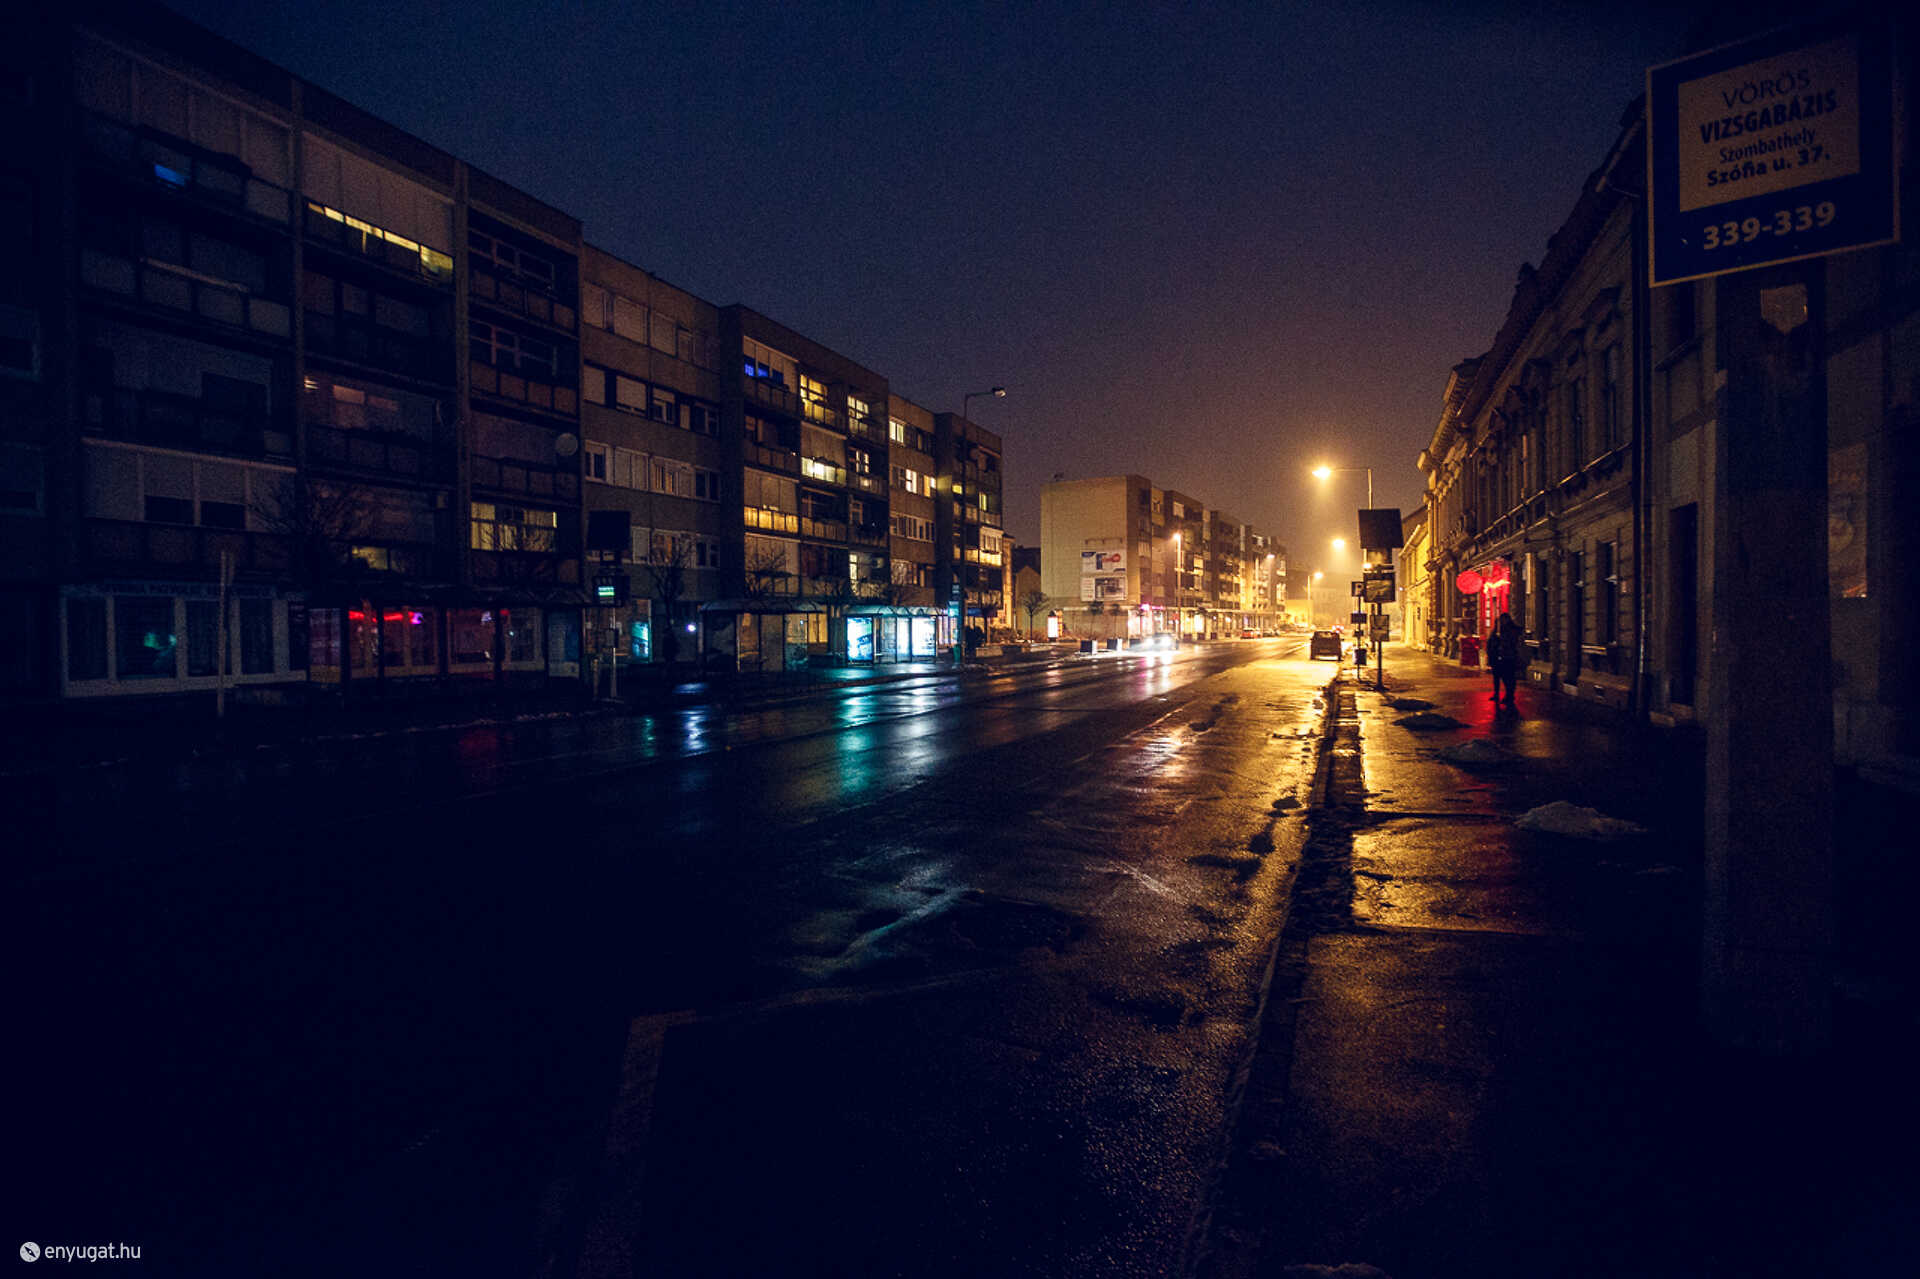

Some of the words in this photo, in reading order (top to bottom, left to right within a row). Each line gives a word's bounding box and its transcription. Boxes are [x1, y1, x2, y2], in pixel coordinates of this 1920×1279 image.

[1722, 70, 1810, 108] VÖRÖS
[1700, 89, 1837, 144] VIZSGABÁZIS
[1707, 161, 1767, 187] Szófia
[1773, 157, 1792, 171] u.
[1797, 145, 1831, 166] 37.
[1719, 127, 1816, 164] Szombathely
[1703, 201, 1836, 250] 339-339
